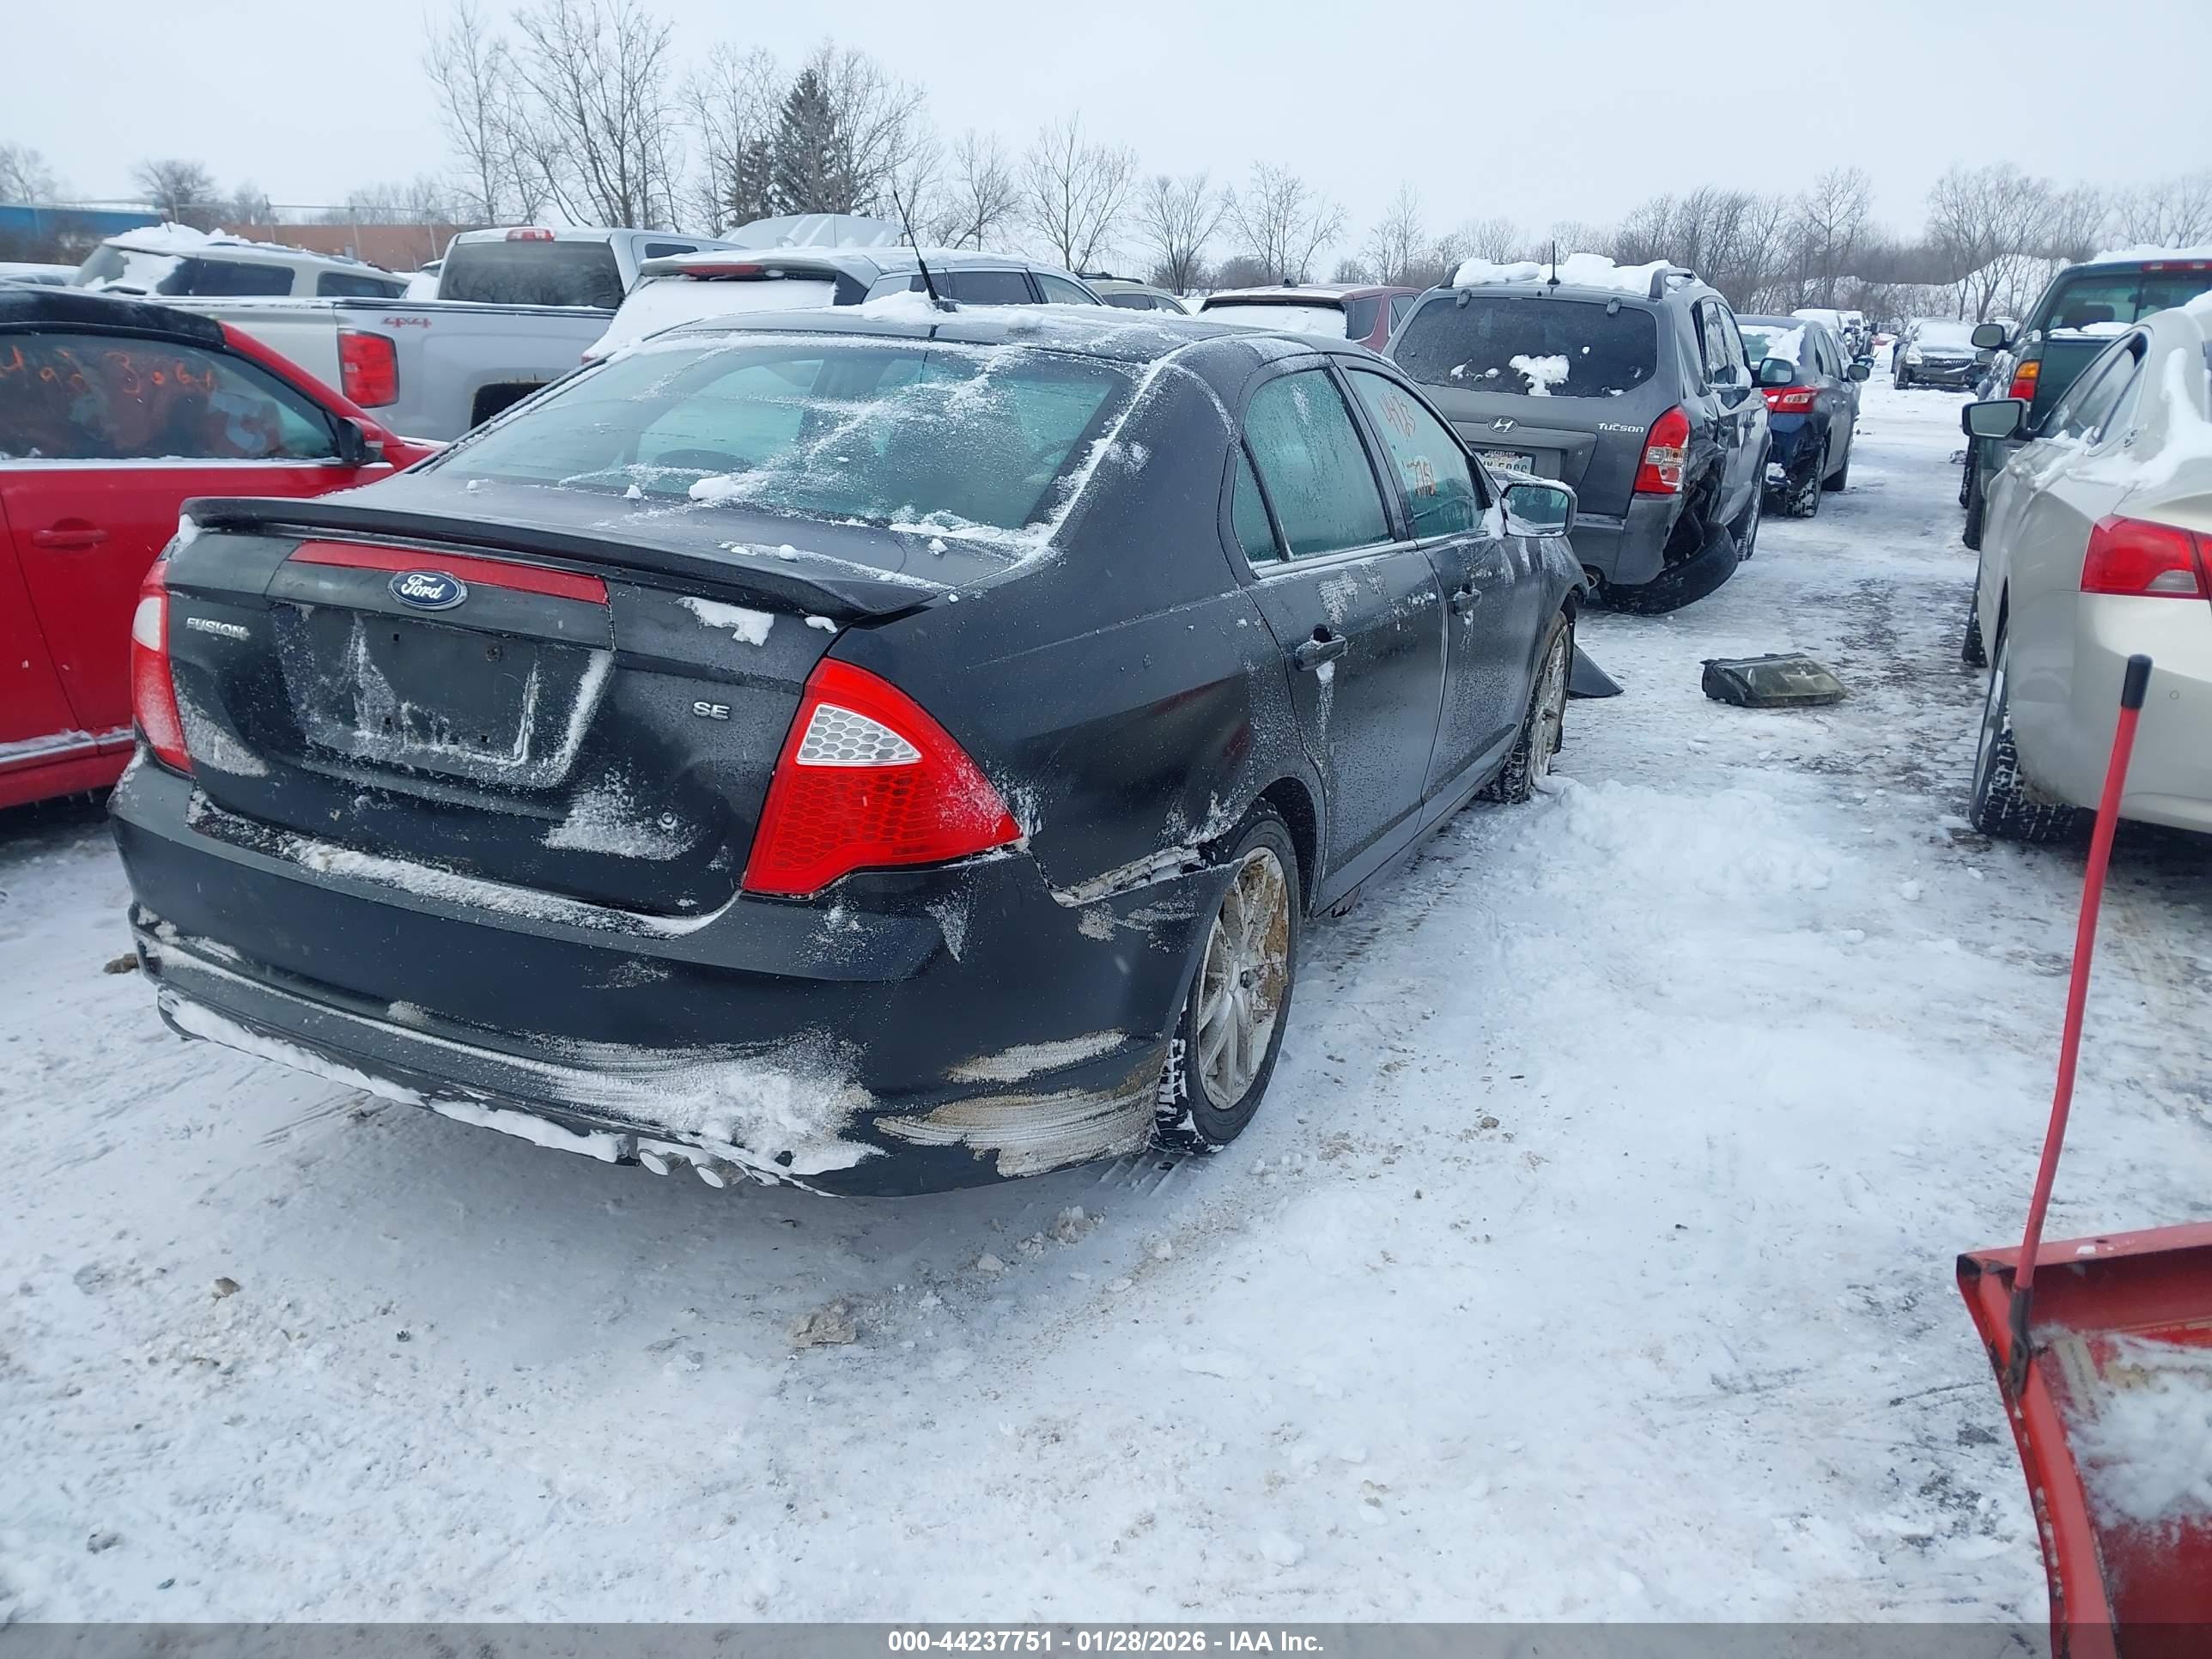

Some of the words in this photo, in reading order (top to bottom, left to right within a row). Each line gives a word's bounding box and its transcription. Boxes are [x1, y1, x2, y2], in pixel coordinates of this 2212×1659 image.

[400, 573, 444, 600] Ford
[186, 617, 251, 641] FUSION
[692, 701, 731, 720] SE
